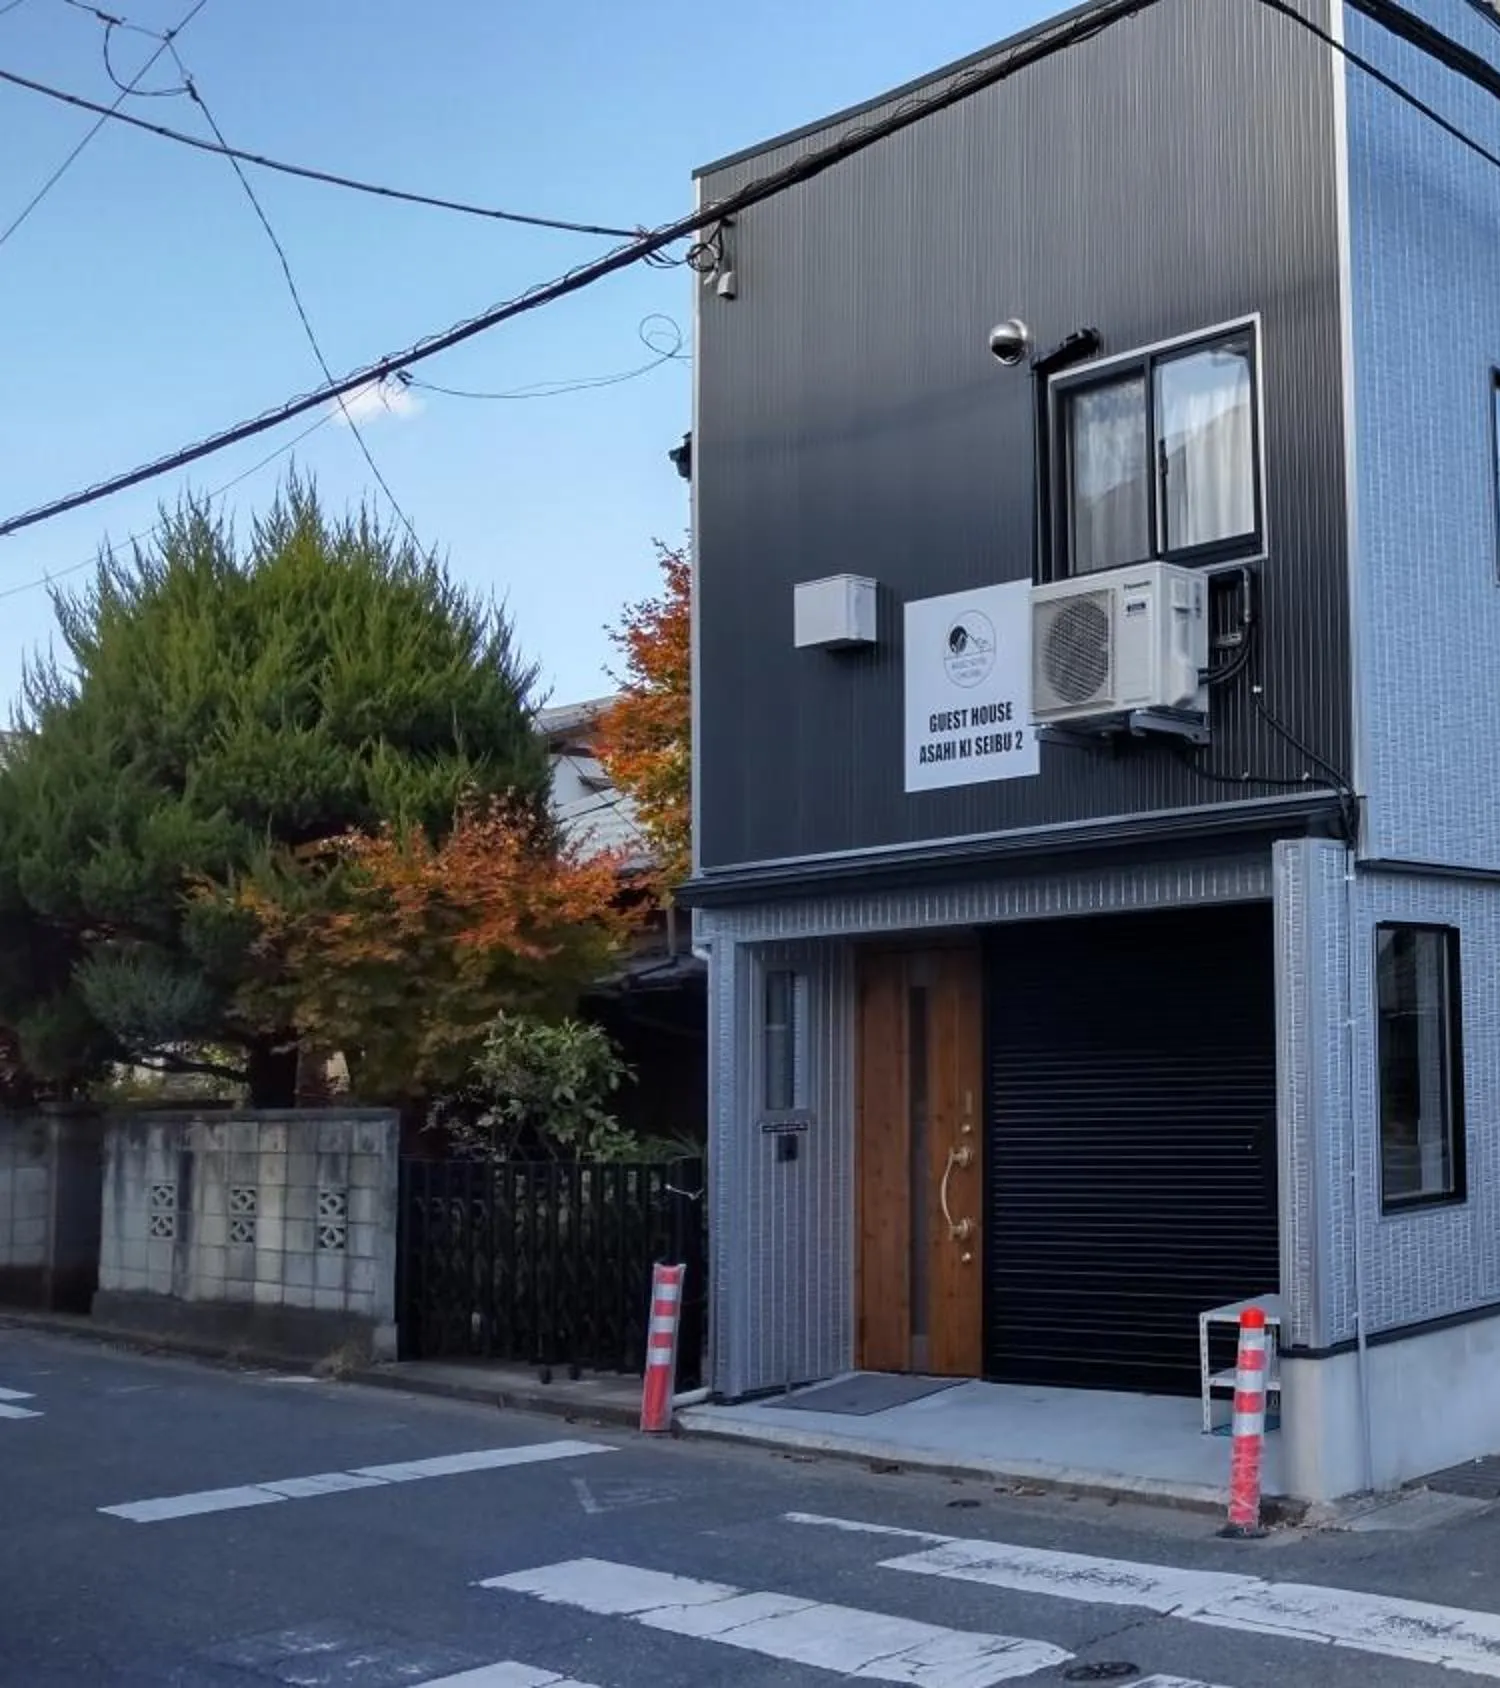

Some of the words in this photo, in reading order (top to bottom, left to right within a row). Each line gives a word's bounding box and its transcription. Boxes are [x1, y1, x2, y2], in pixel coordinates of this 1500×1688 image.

[929, 709, 969, 733] GUEST
[971, 701, 1013, 727] HOUSE
[919, 740, 957, 764] ASAHI
[959, 738, 972, 759] KI
[975, 731, 1013, 756] SEIBU
[1015, 730, 1023, 750] 2
